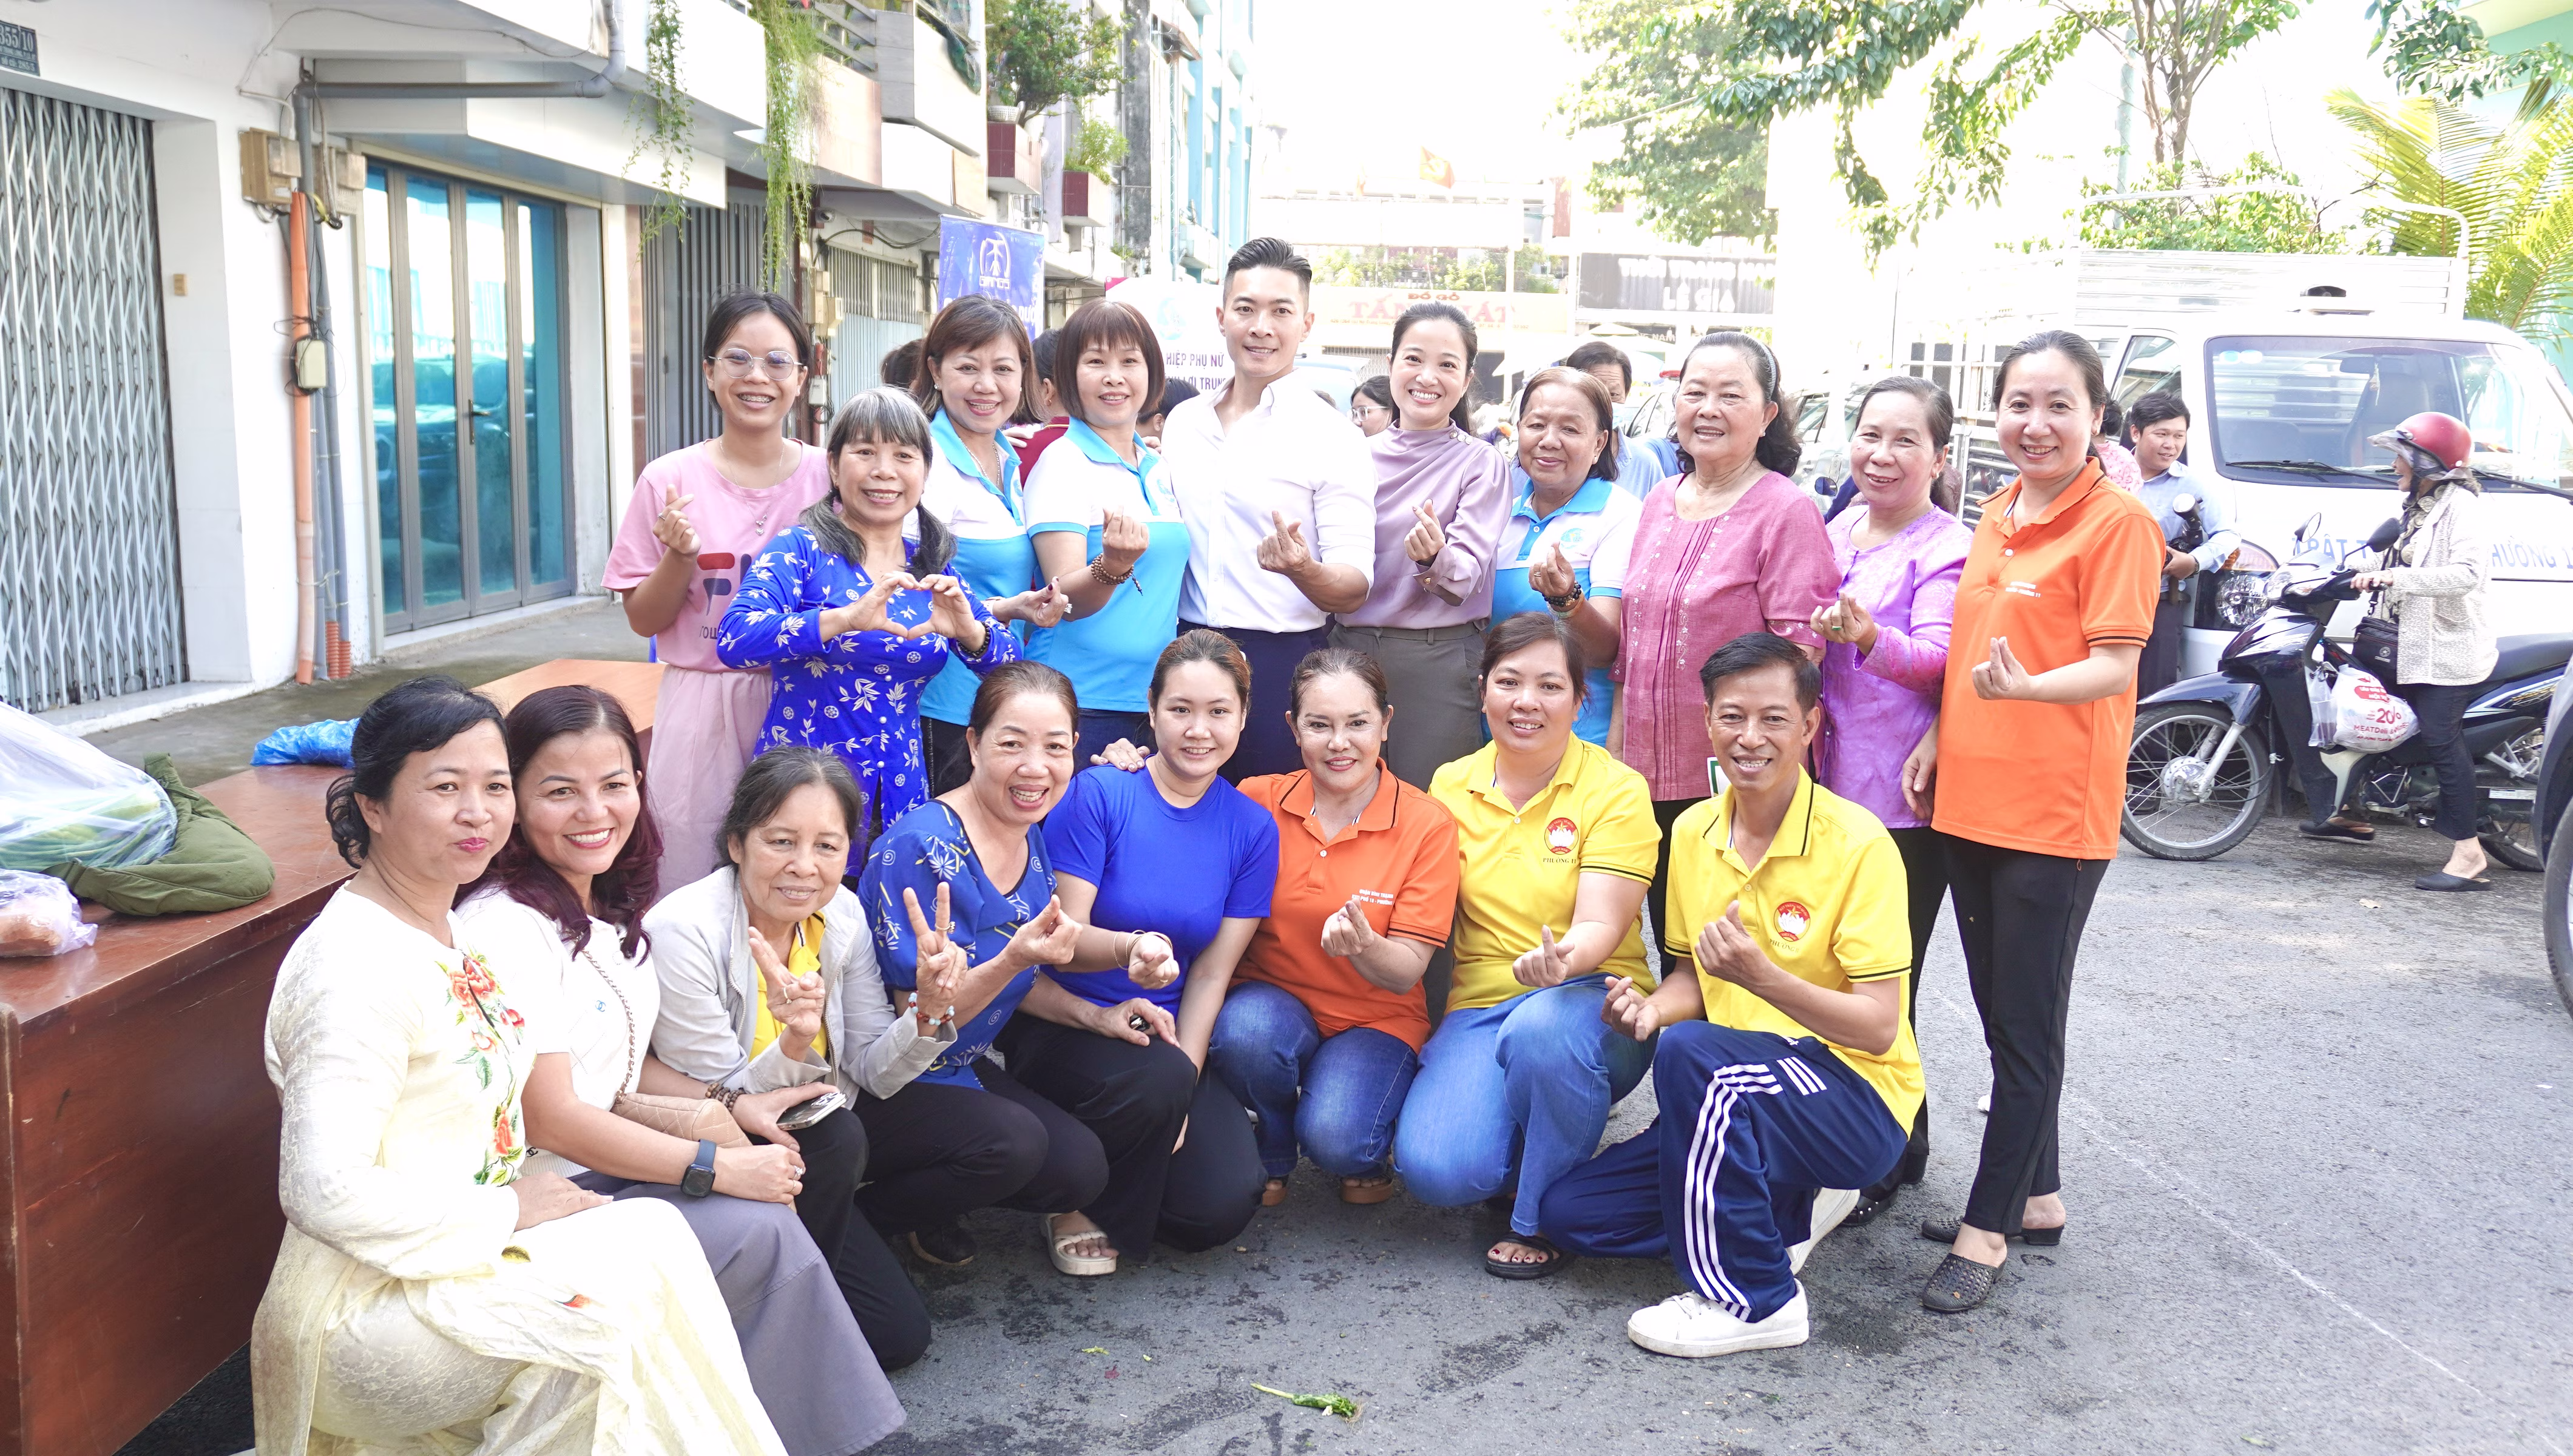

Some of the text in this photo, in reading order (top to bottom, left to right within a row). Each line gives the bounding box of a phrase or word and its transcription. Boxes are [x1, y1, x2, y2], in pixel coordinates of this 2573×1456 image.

[1662, 278, 1689, 311] LÊ
[1166, 349, 1225, 369] HIỆP PHỤ NỮ
[1200, 376, 1226, 390] TRUN
[2492, 536, 2557, 568] HƯỜNG
[2353, 724, 2389, 734] MEATDeli
